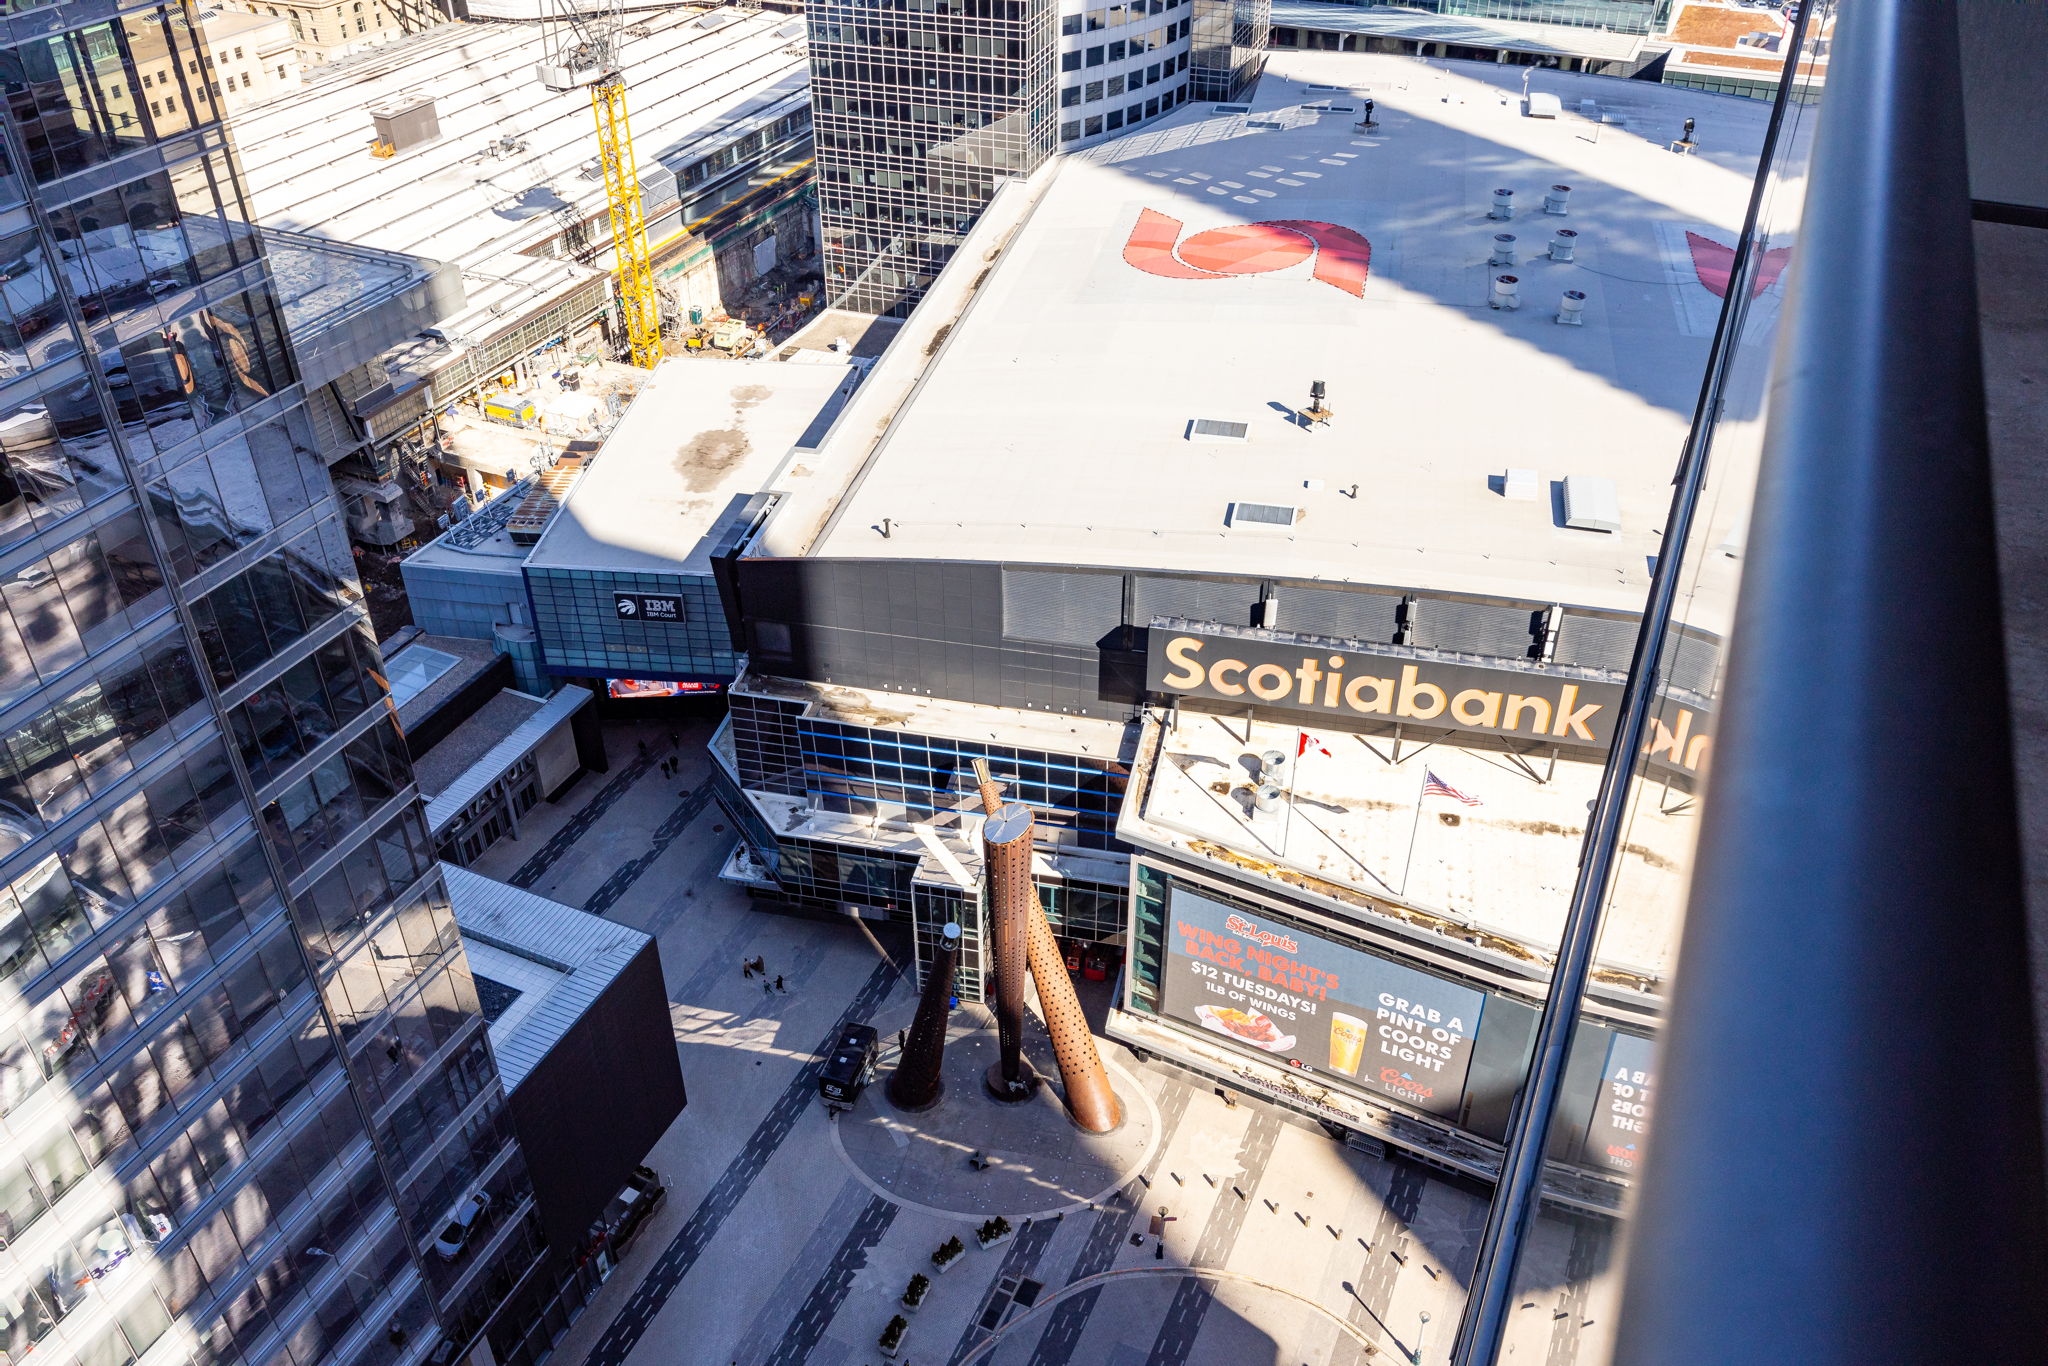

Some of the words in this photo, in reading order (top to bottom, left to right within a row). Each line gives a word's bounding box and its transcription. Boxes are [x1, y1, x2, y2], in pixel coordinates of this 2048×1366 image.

[645, 599, 676, 612] IBM
[1162, 636, 1605, 742] Scotiabank
[1177, 919, 1242, 955] WING
[1247, 944, 1340, 990] NIGHT'S
[1185, 940, 1251, 977] BACK,
[1258, 965, 1327, 1002] BABY!
[1191, 960, 1218, 980] $12
[1222, 971, 1317, 1015] TUESDAYS!
[1205, 981, 1226, 996] 1LB
[1228, 989, 1246, 1002] OF
[1250, 996, 1297, 1021] WINGS
[1376, 1007, 1426, 1034] PINT
[1432, 1028, 1462, 1046] OF
[1378, 992, 1441, 1024] GRAB
[1447, 1017, 1464, 1032] A
[1378, 1025, 1452, 1060] COORS
[1380, 1040, 1445, 1073] LIGHT
[1301, 1063, 1313, 1073] LG
[1380, 1066, 1434, 1098] Coors
[1241, 1071, 1317, 1109] Scotiabank
[1319, 1102, 1360, 1124] Arena
[1384, 1082, 1426, 1103] LIGHT
